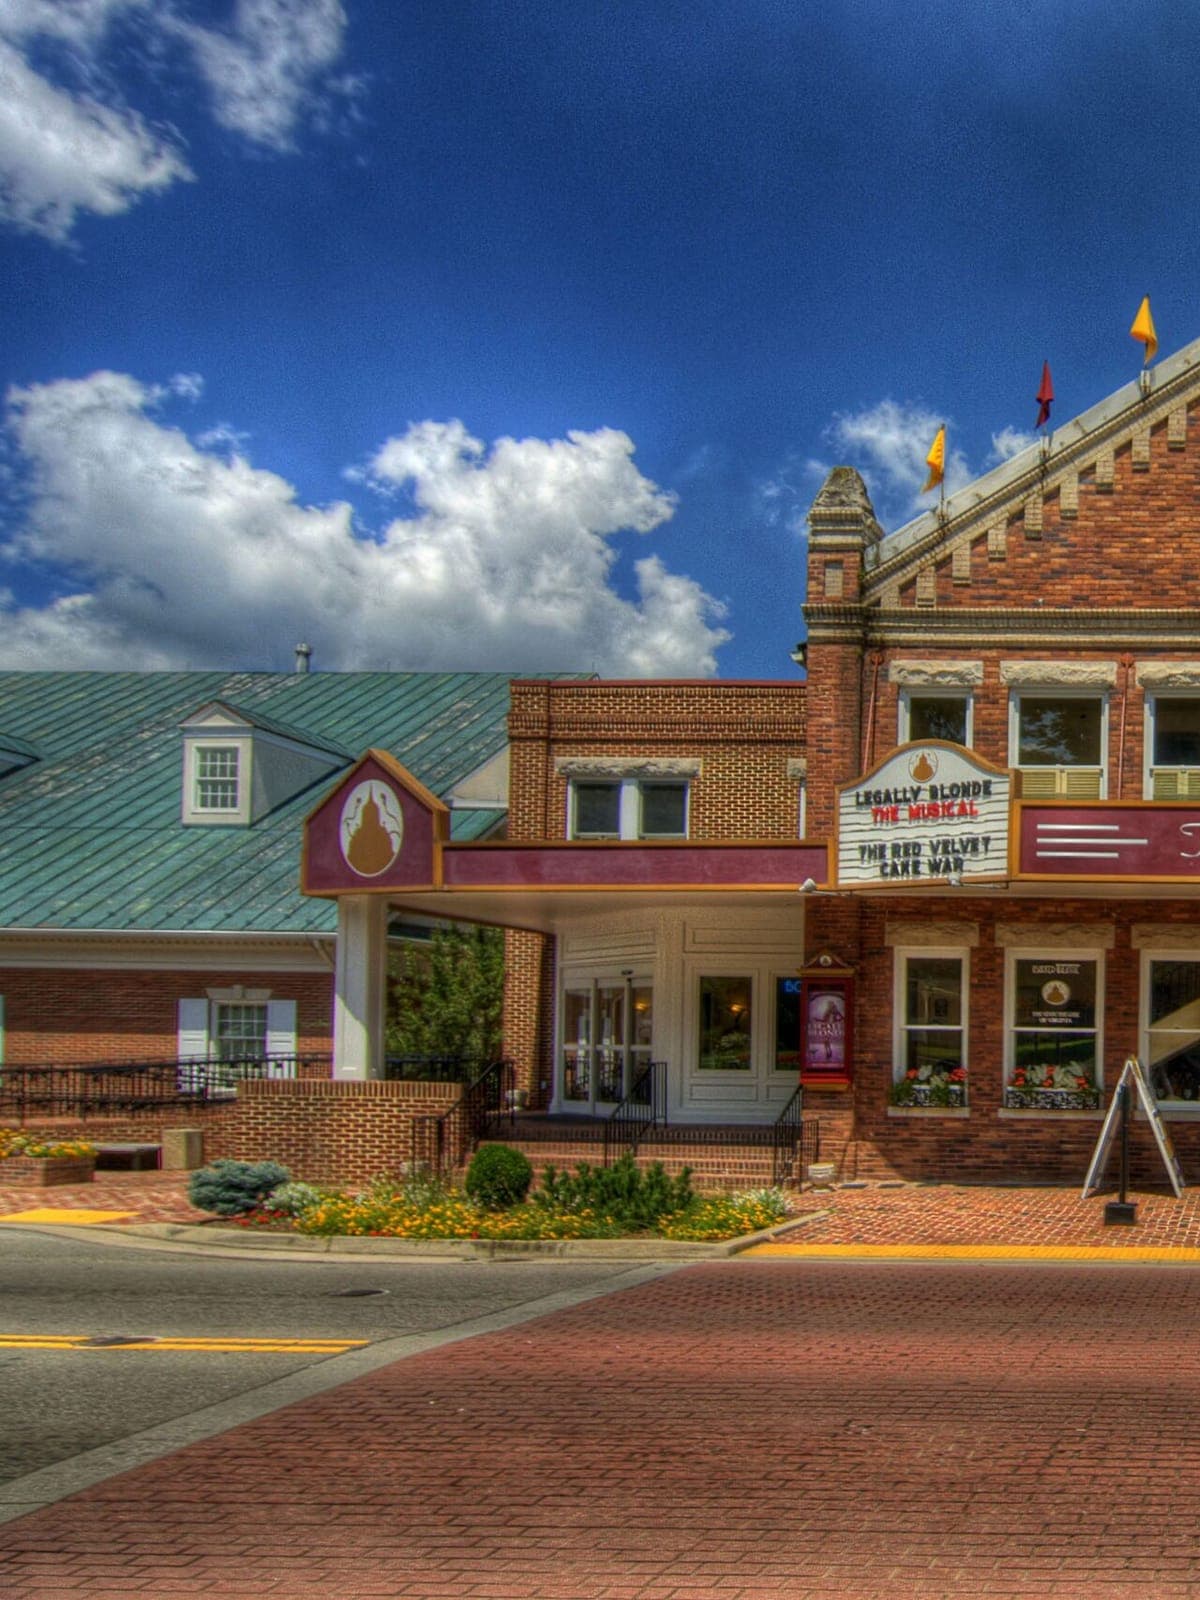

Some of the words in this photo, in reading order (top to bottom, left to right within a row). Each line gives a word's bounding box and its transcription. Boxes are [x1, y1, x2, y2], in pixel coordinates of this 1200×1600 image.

[856, 786, 921, 805] LEGALLY
[929, 780, 992, 799] BLONDE
[871, 805, 899, 823] THE
[908, 799, 979, 820] MUSICAL
[859, 844, 886, 861] THE
[891, 841, 922, 857] RED
[929, 836, 991, 855] VELVET
[880, 859, 921, 876] CAKE
[927, 857, 964, 874] WAR
